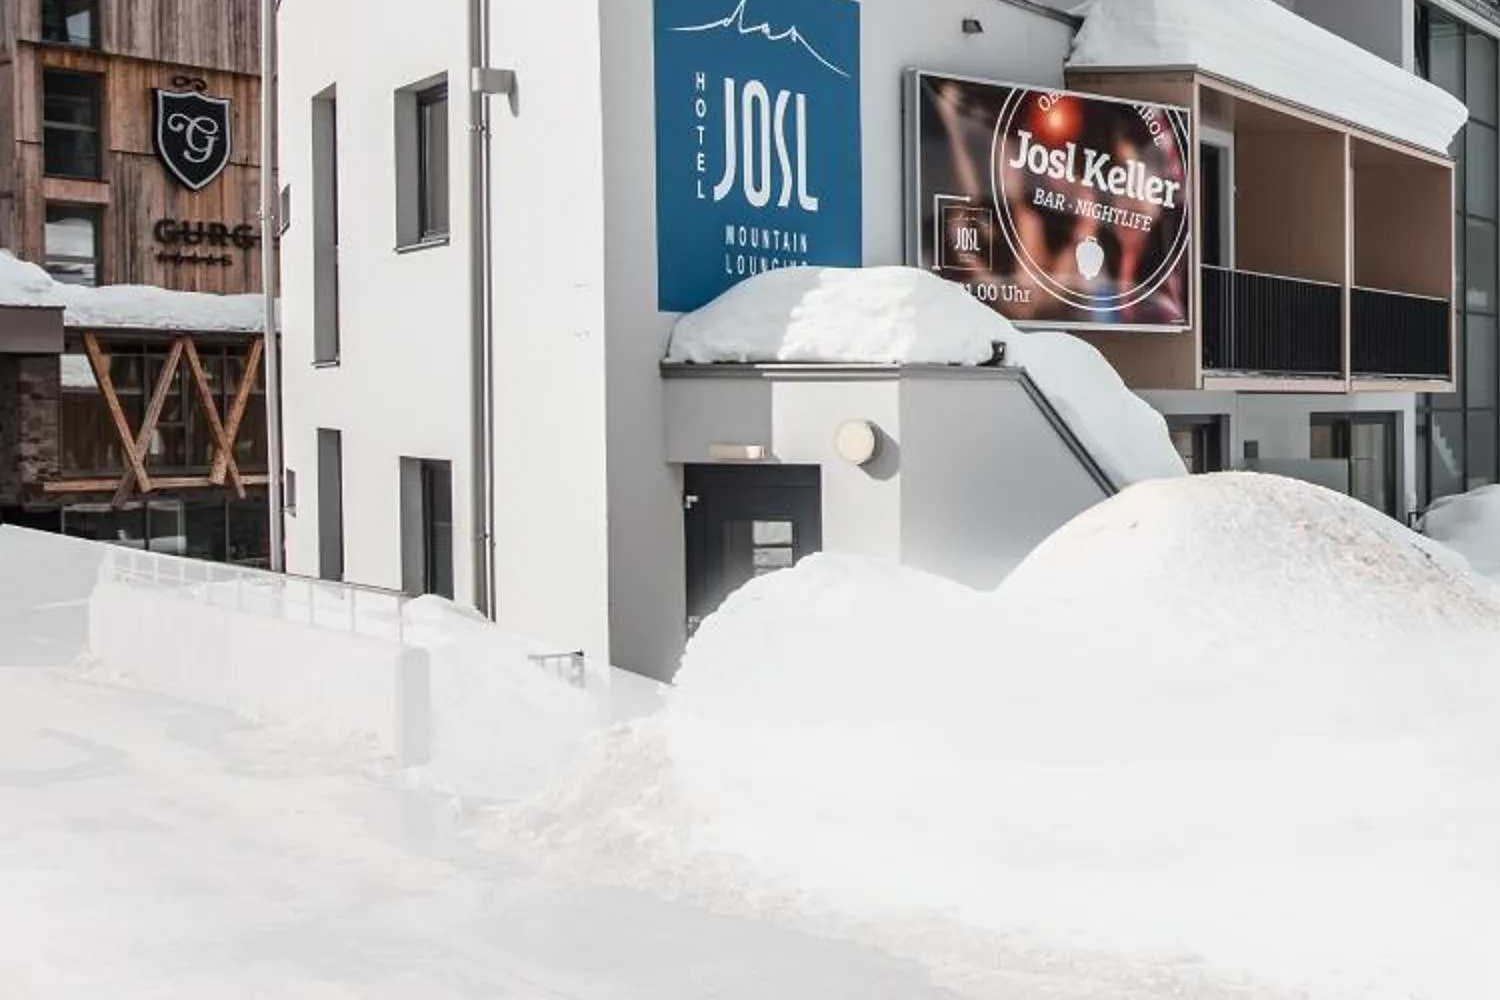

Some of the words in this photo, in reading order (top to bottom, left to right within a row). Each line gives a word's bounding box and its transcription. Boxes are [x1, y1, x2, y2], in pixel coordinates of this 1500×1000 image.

[695, 71, 707, 199] HOTEL
[713, 77, 819, 211] JOSL
[1009, 129, 1078, 183] Josl
[1081, 147, 1181, 209] Keller
[1033, 187, 1066, 211] BAR
[1075, 199, 1154, 233] NIGHTLIFE
[725, 225, 807, 253] MOUNTAIN
[954, 227, 981, 251] JOSL
[1001, 284, 1032, 303] Uhr
